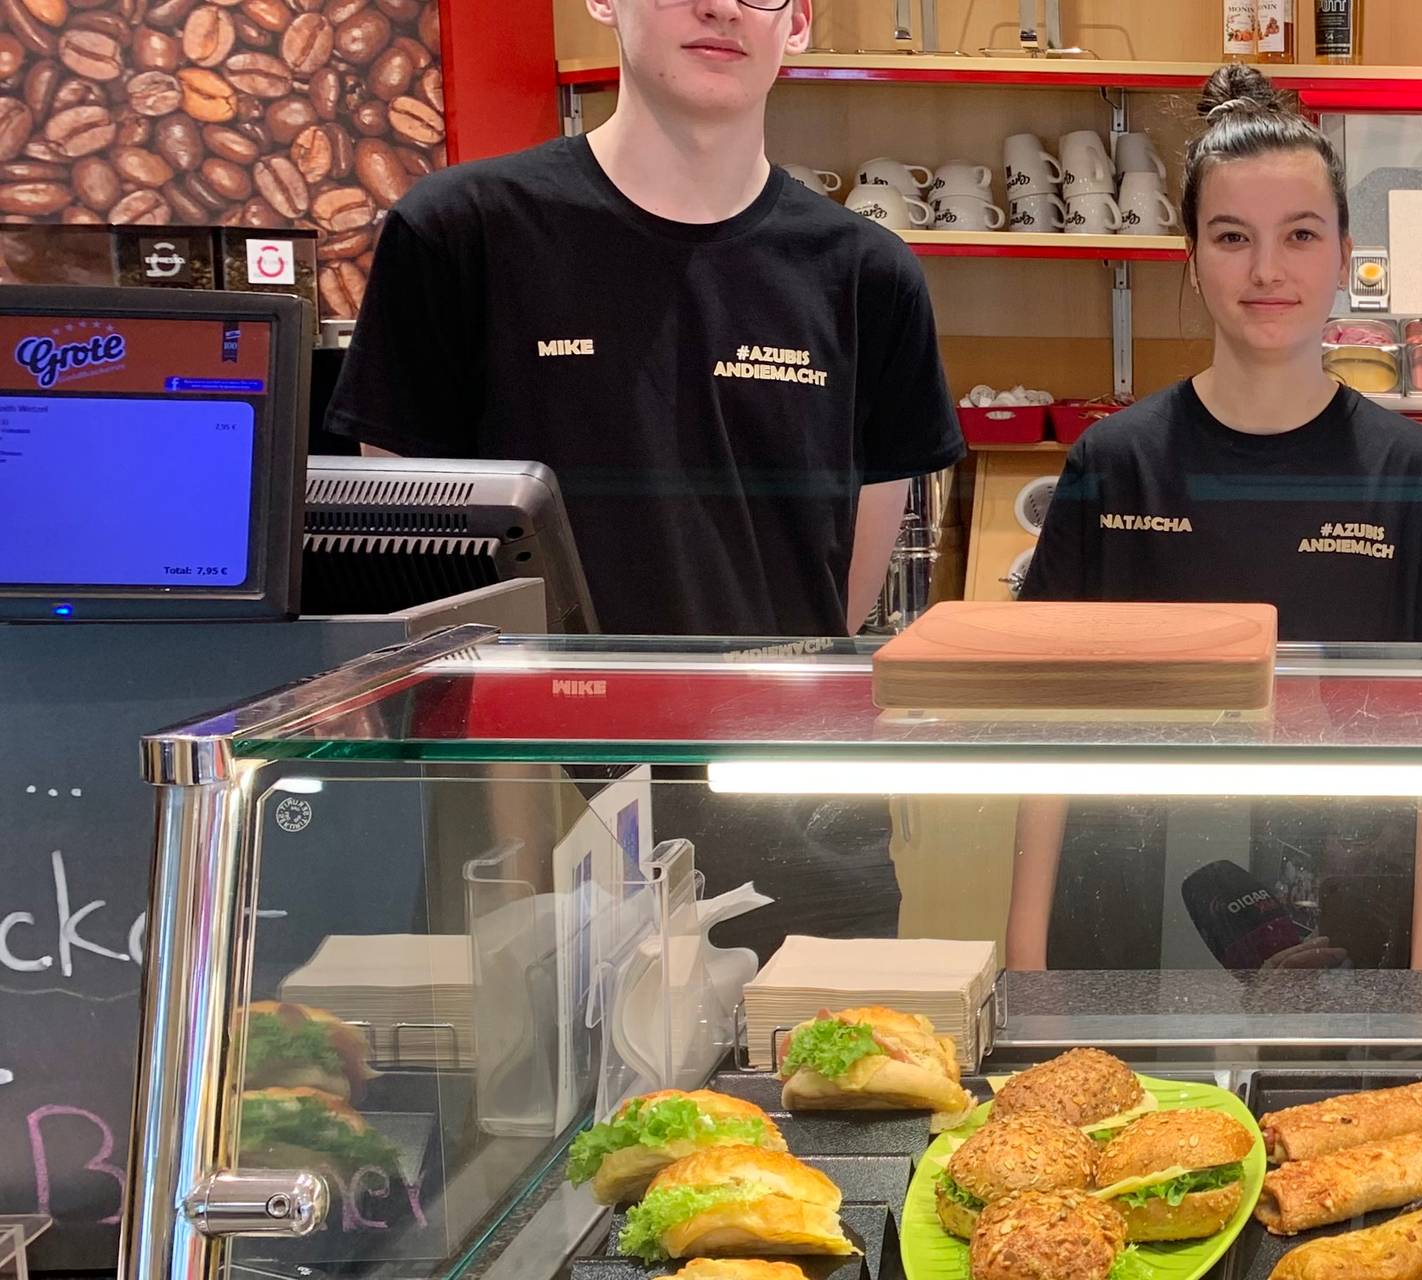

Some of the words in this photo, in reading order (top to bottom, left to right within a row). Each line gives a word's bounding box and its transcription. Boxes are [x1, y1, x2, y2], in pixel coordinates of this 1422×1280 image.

[537, 339, 595, 357] MIKE
[736, 345, 810, 366] #AZUBIS
[16, 333, 126, 388] Grote
[713, 361, 828, 387] ANDIEMACHT
[1099, 514, 1193, 533] NATASCHA
[1320, 522, 1385, 541] #AZUBIS
[163, 566, 192, 575] Total:
[196, 566, 218, 576] 7,95
